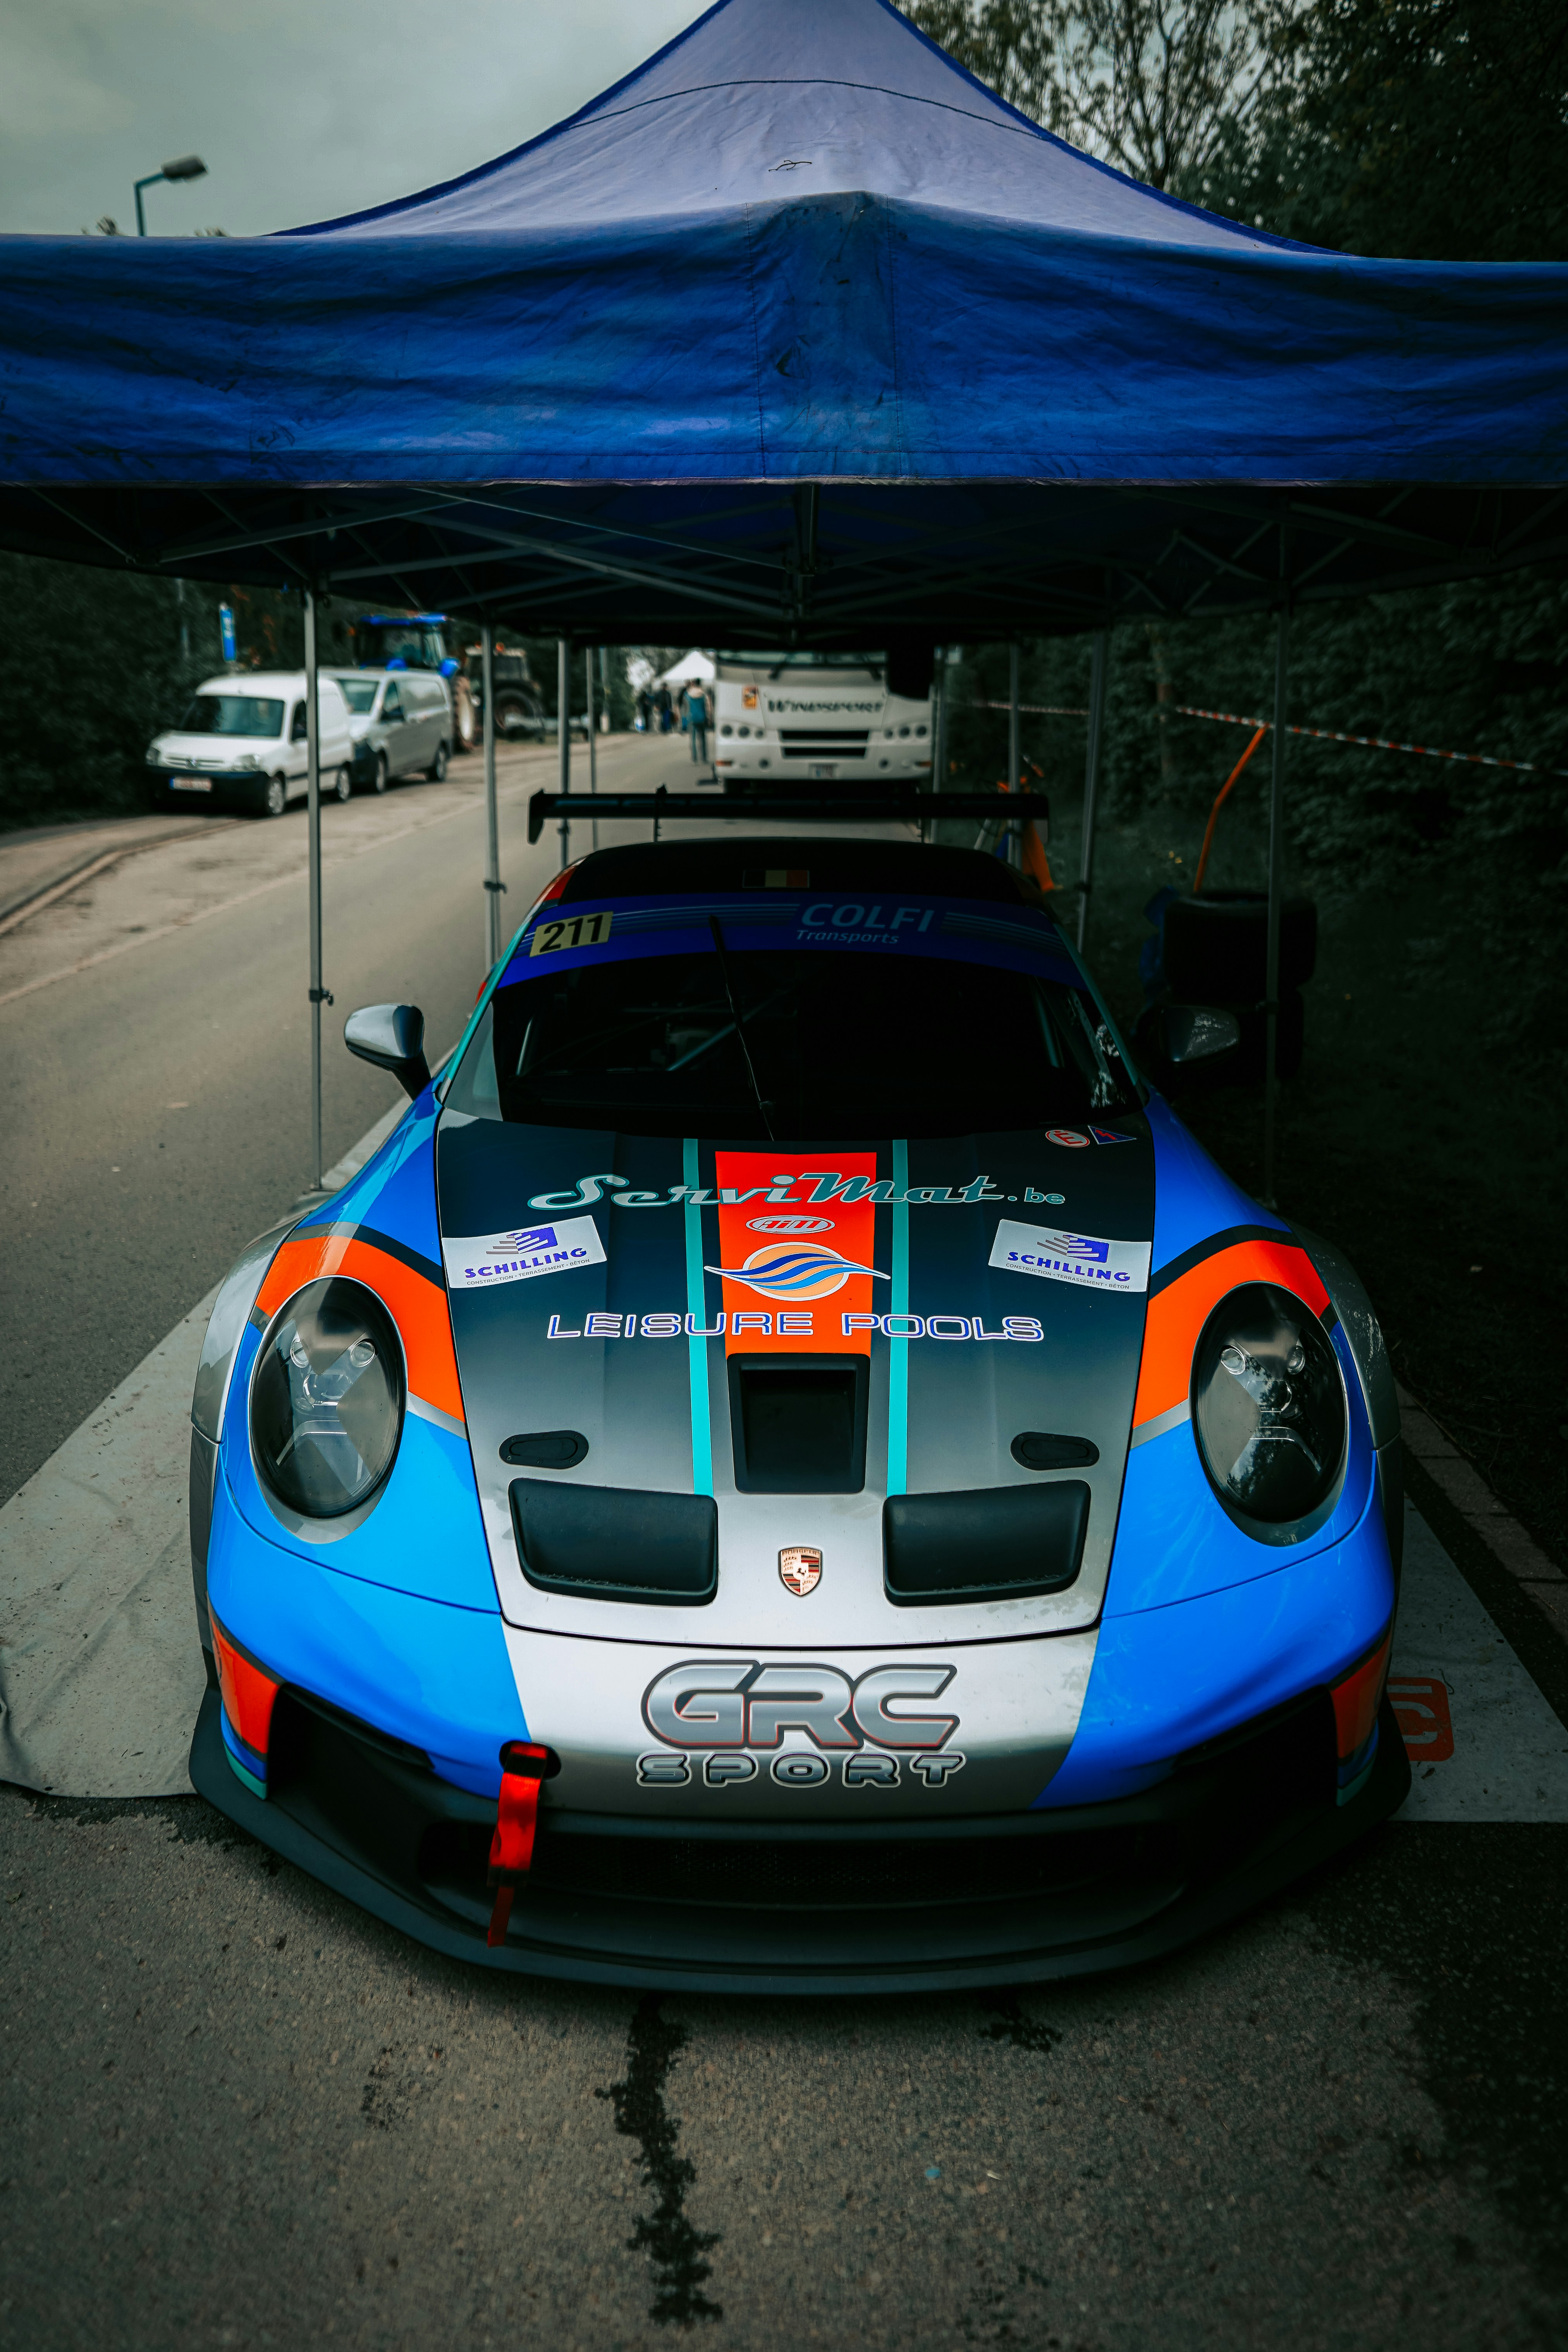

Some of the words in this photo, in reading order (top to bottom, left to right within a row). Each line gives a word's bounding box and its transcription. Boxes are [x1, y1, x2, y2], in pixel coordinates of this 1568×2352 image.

[801, 903, 934, 932] COLFI
[540, 915, 603, 953] 211
[796, 930, 899, 944] Transports
[464, 1248, 587, 1278] SCHILLING
[466, 1275, 514, 1285] CONSTRUCTION
[518, 1264, 564, 1277] TERRASSEMENT
[1006, 1263, 1052, 1276] CONSTRUCTION
[1057, 1273, 1104, 1286] TERRASSEMENT
[1007, 1252, 1130, 1282] SCHILLING
[547, 1312, 813, 1339] LEISURE
[842, 1313, 1044, 1341] POOLS
[641, 1659, 960, 1752] GRC
[636, 1753, 966, 1788] SPORT
